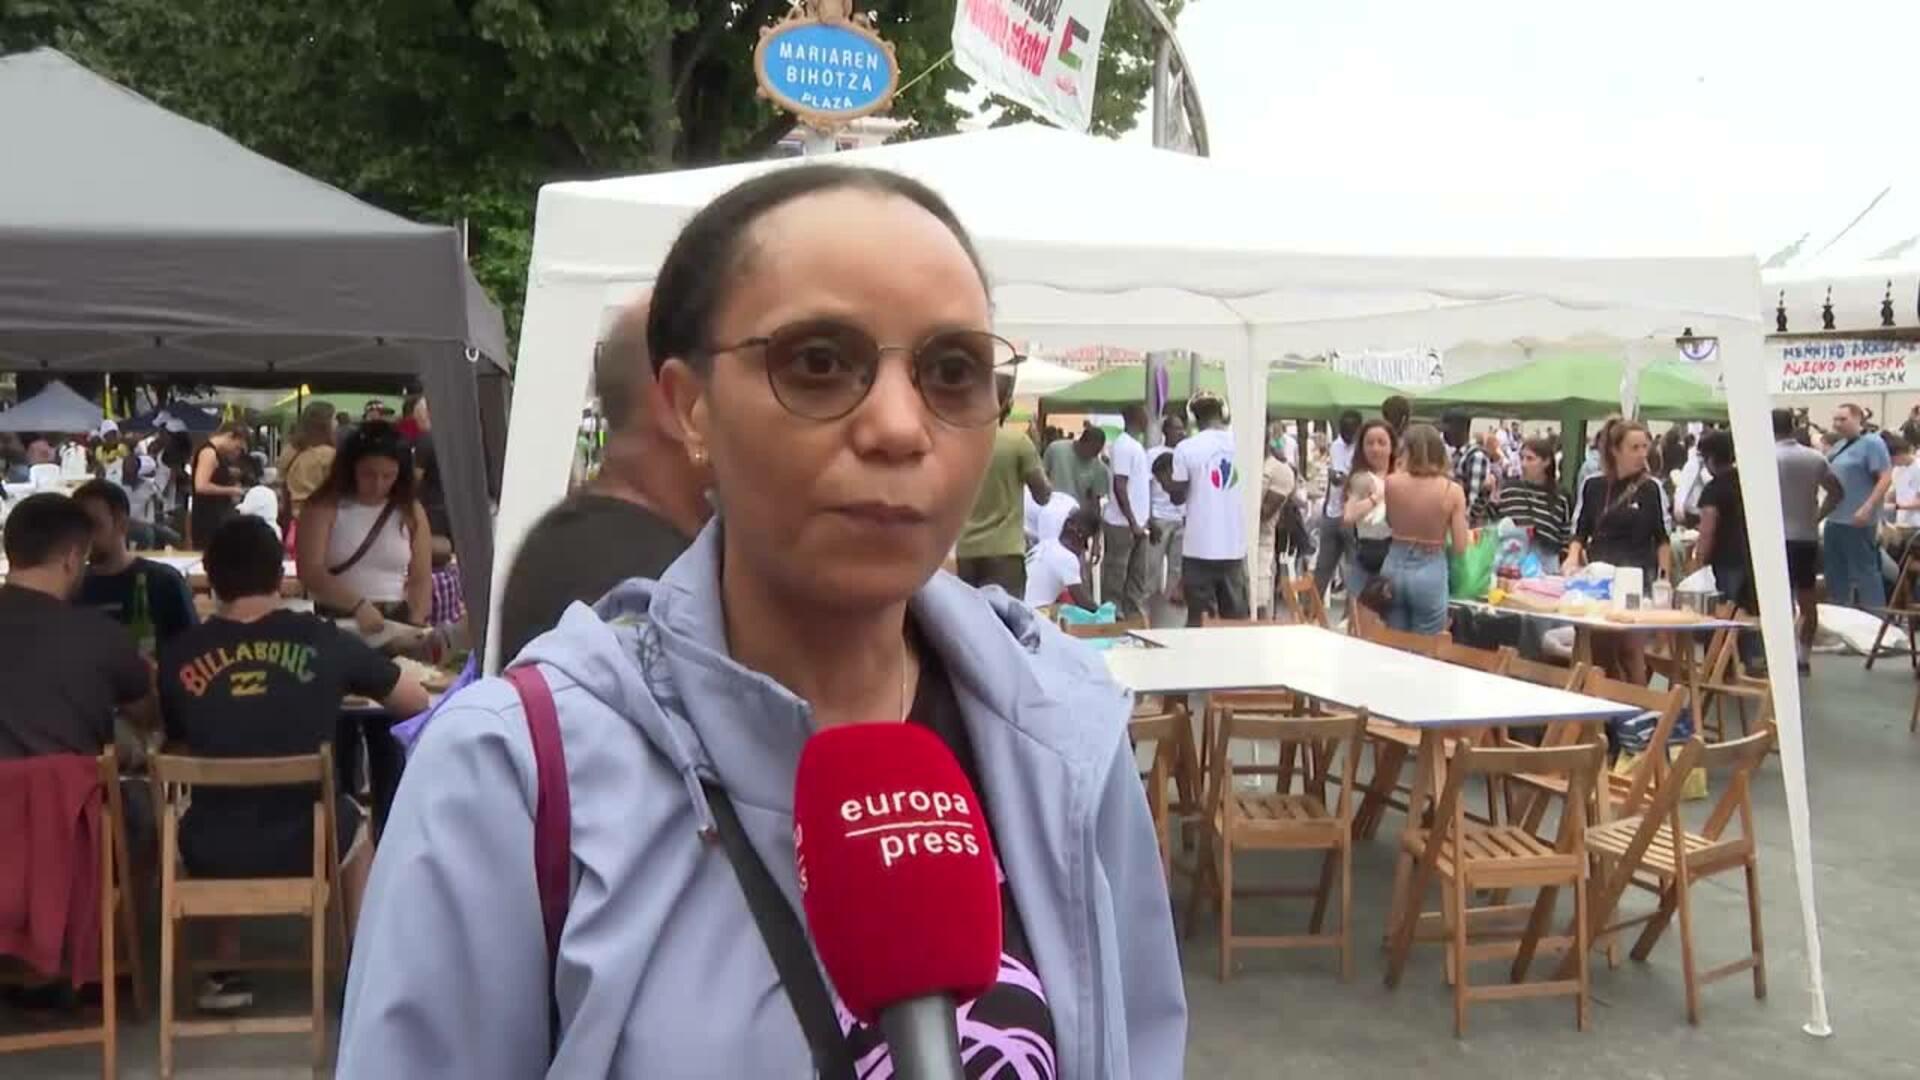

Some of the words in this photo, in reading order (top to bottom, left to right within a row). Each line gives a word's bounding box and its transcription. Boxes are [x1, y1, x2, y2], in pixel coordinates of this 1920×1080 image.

[779, 41, 879, 71] MARIAREN
[786, 65, 873, 92] BIHOTZA
[801, 91, 853, 109] PLAZA
[1843, 356, 1905, 372] AHOTSAK
[179, 642, 317, 697] BILLABONG
[840, 790, 970, 823] europa
[879, 829, 980, 868] press
